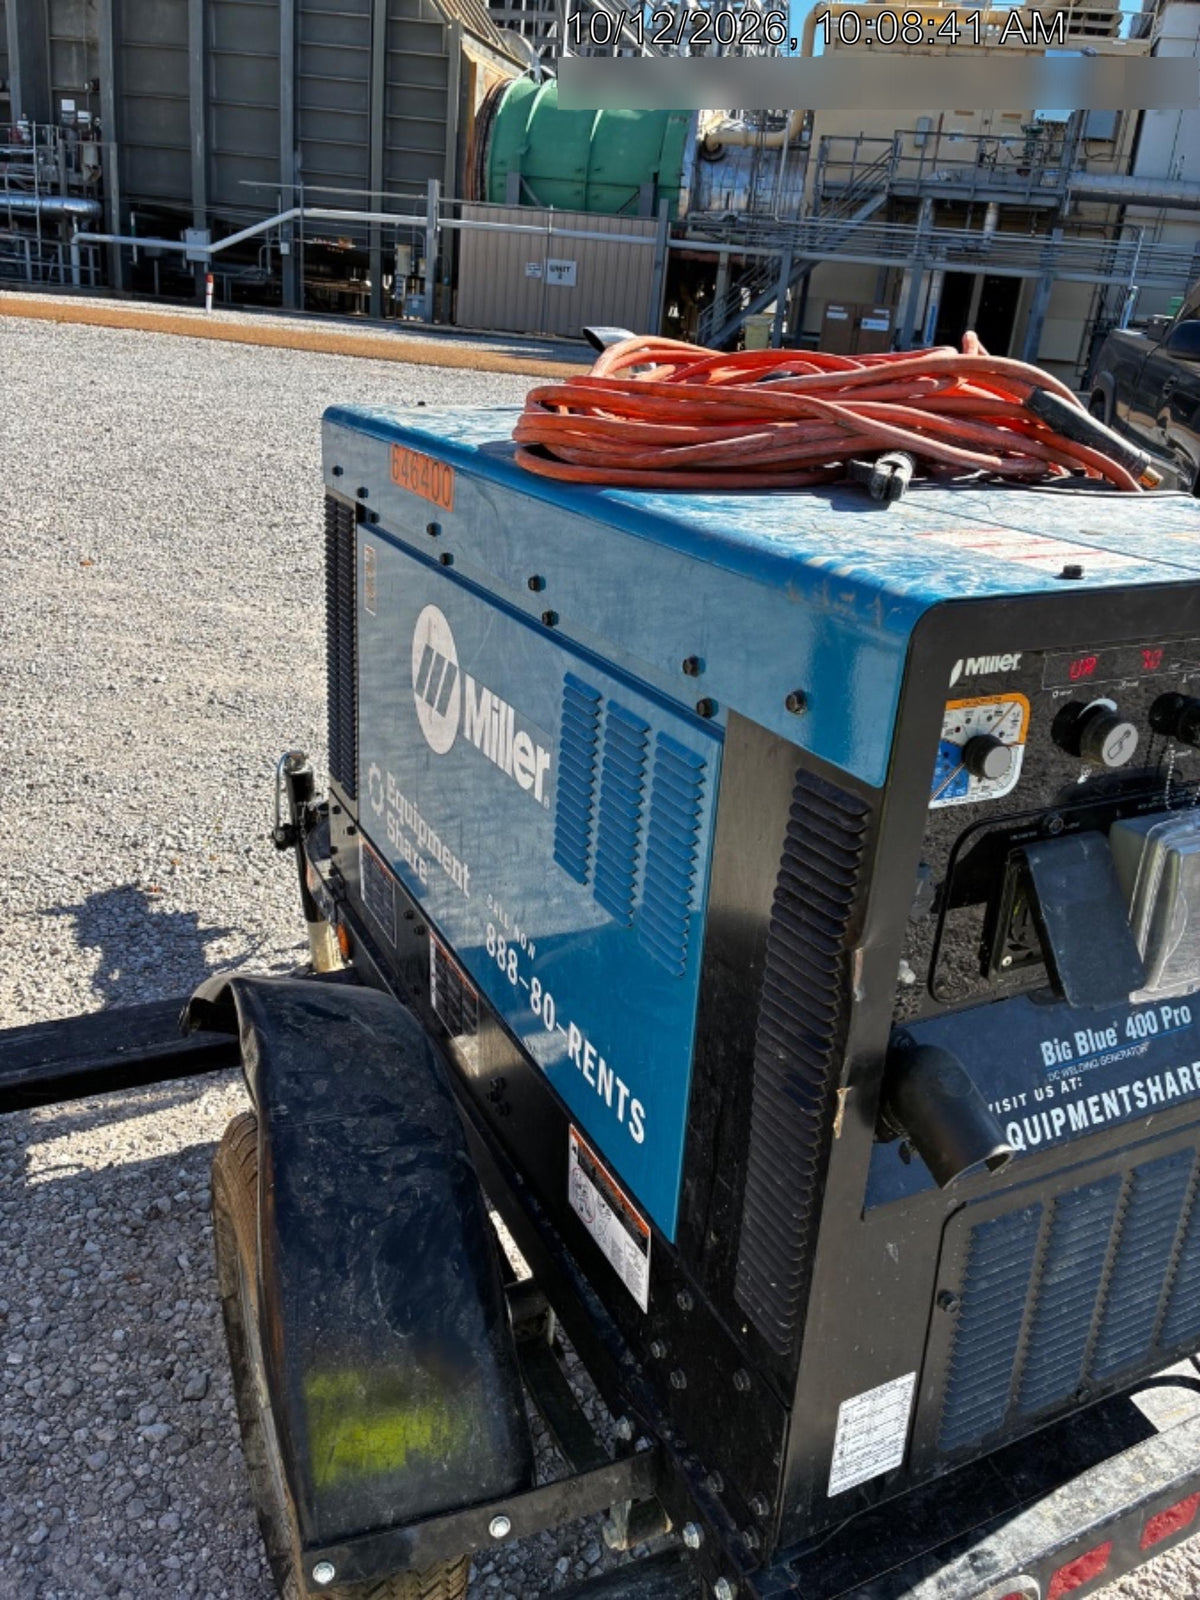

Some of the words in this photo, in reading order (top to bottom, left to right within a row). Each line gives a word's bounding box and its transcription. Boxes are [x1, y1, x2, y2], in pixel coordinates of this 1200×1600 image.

[392, 443, 453, 508] 646400
[964, 652, 1023, 677] Miller
[464, 672, 550, 804] Miller
[386, 771, 471, 899] Equipment
[386, 810, 428, 886] Share
[485, 922, 646, 1145] 888-80-RENTS
[1040, 1037, 1074, 1068] Big
[1073, 1027, 1119, 1058] Blue
[1125, 1010, 1159, 1040] 400
[1160, 1005, 1193, 1031] Pro
[1034, 1085, 1055, 1102] US
[1061, 1076, 1083, 1095] AT:
